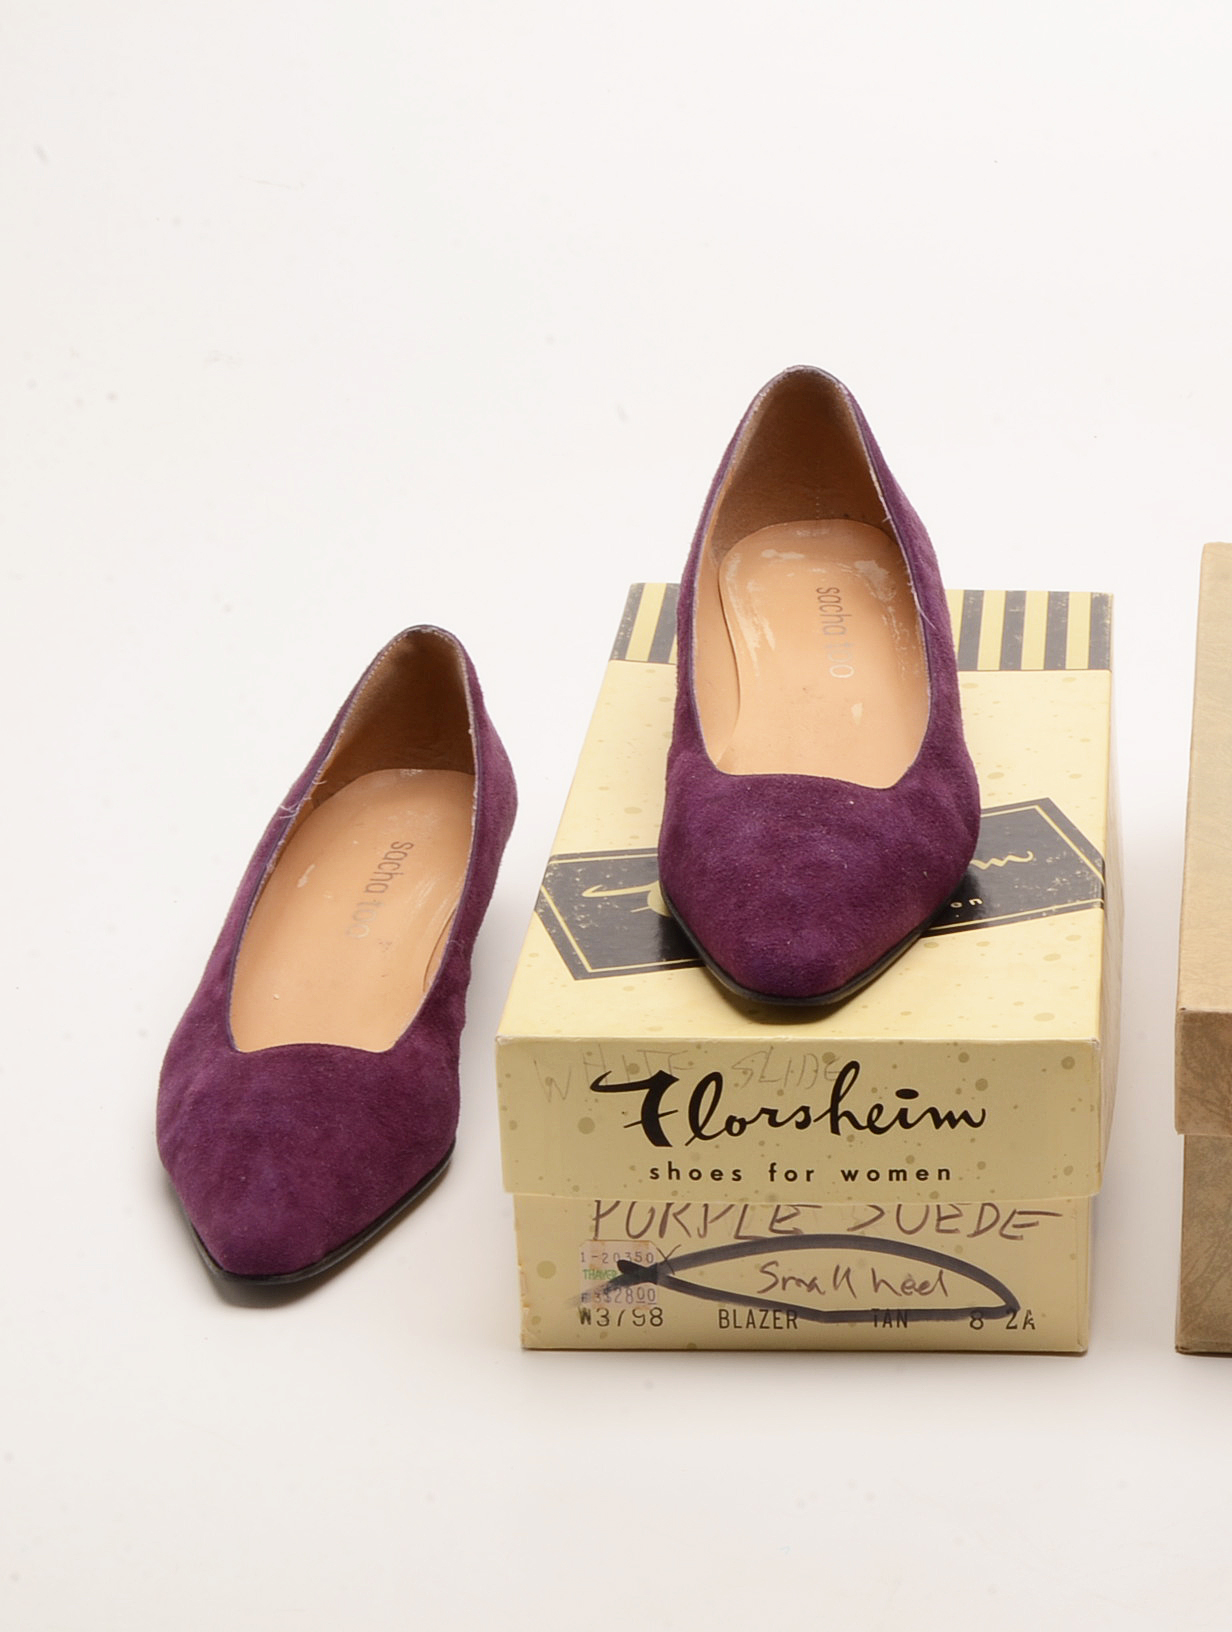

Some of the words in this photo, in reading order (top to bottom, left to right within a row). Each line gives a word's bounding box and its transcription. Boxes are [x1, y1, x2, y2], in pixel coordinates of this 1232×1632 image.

[815, 586, 853, 636] sacha
[363, 840, 415, 894] sacha
[589, 1060, 986, 1148] Florsheim
[649, 1160, 743, 1182] shoes
[768, 1161, 815, 1183] for
[840, 1168, 951, 1183] women
[592, 1200, 822, 1240] PURPLE
[718, 1308, 798, 1331] BLAZER
[872, 1308, 909, 1330] TAN
[968, 1310, 985, 1331] 8
